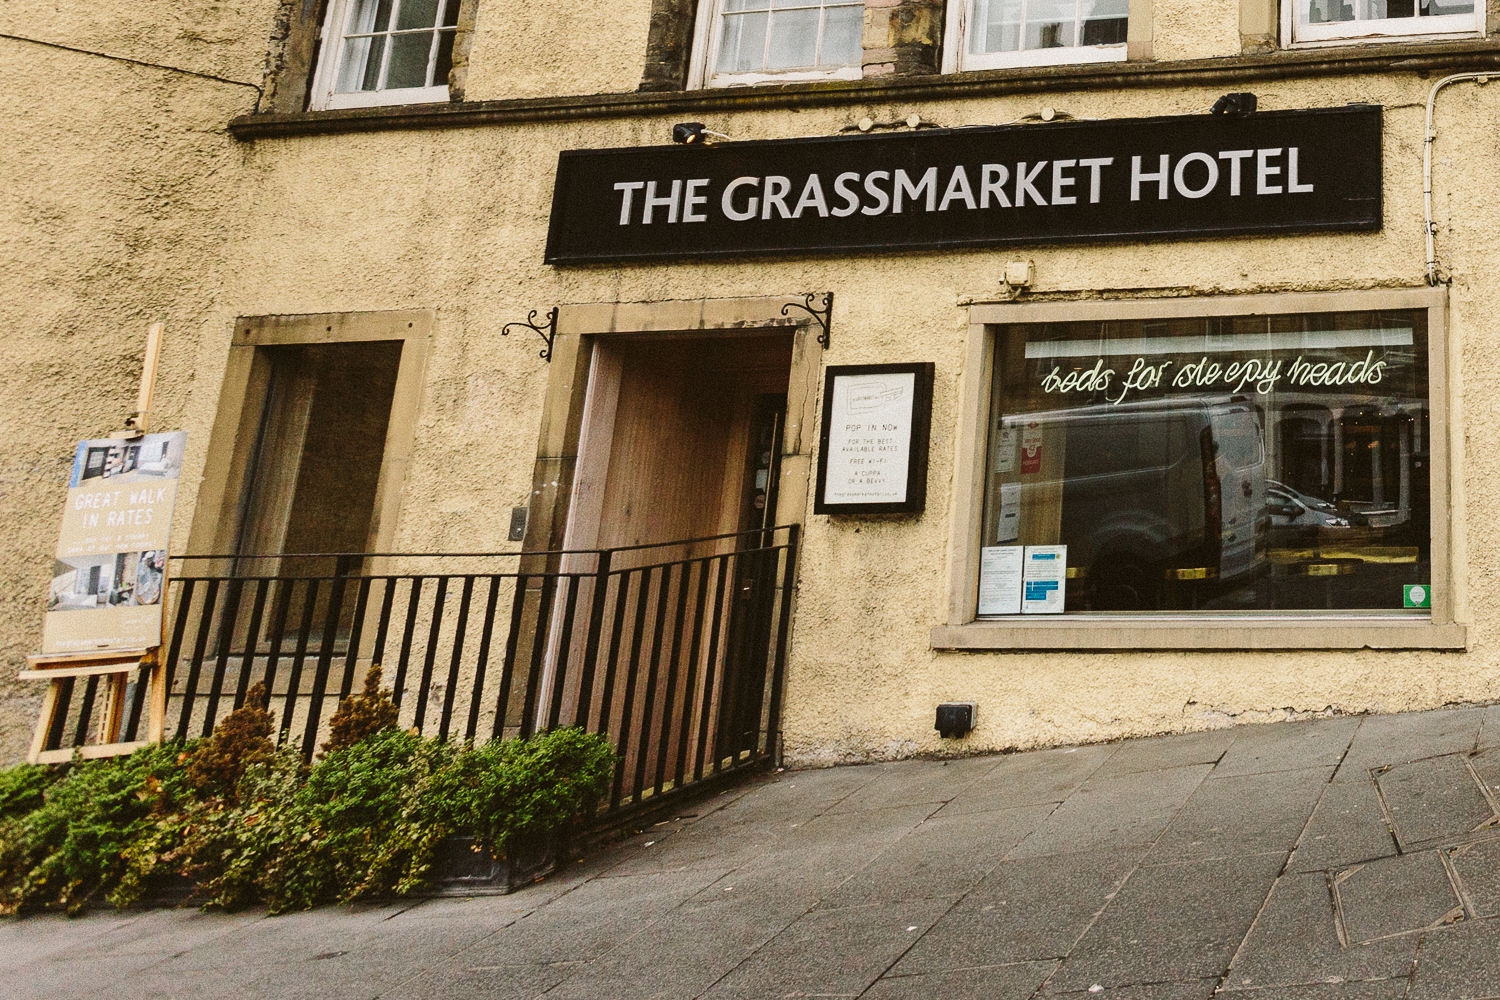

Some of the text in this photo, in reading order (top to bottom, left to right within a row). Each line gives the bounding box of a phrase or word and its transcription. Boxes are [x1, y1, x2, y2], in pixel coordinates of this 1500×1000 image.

[613, 146, 1314, 226] THE GRASSMARKET HOTEL
[1042, 350, 1388, 406] beds for sleepy heads
[845, 423, 898, 432] POP IN NOW
[74, 487, 167, 511] GREAT WALK
[82, 509, 153, 529] IN RATES
